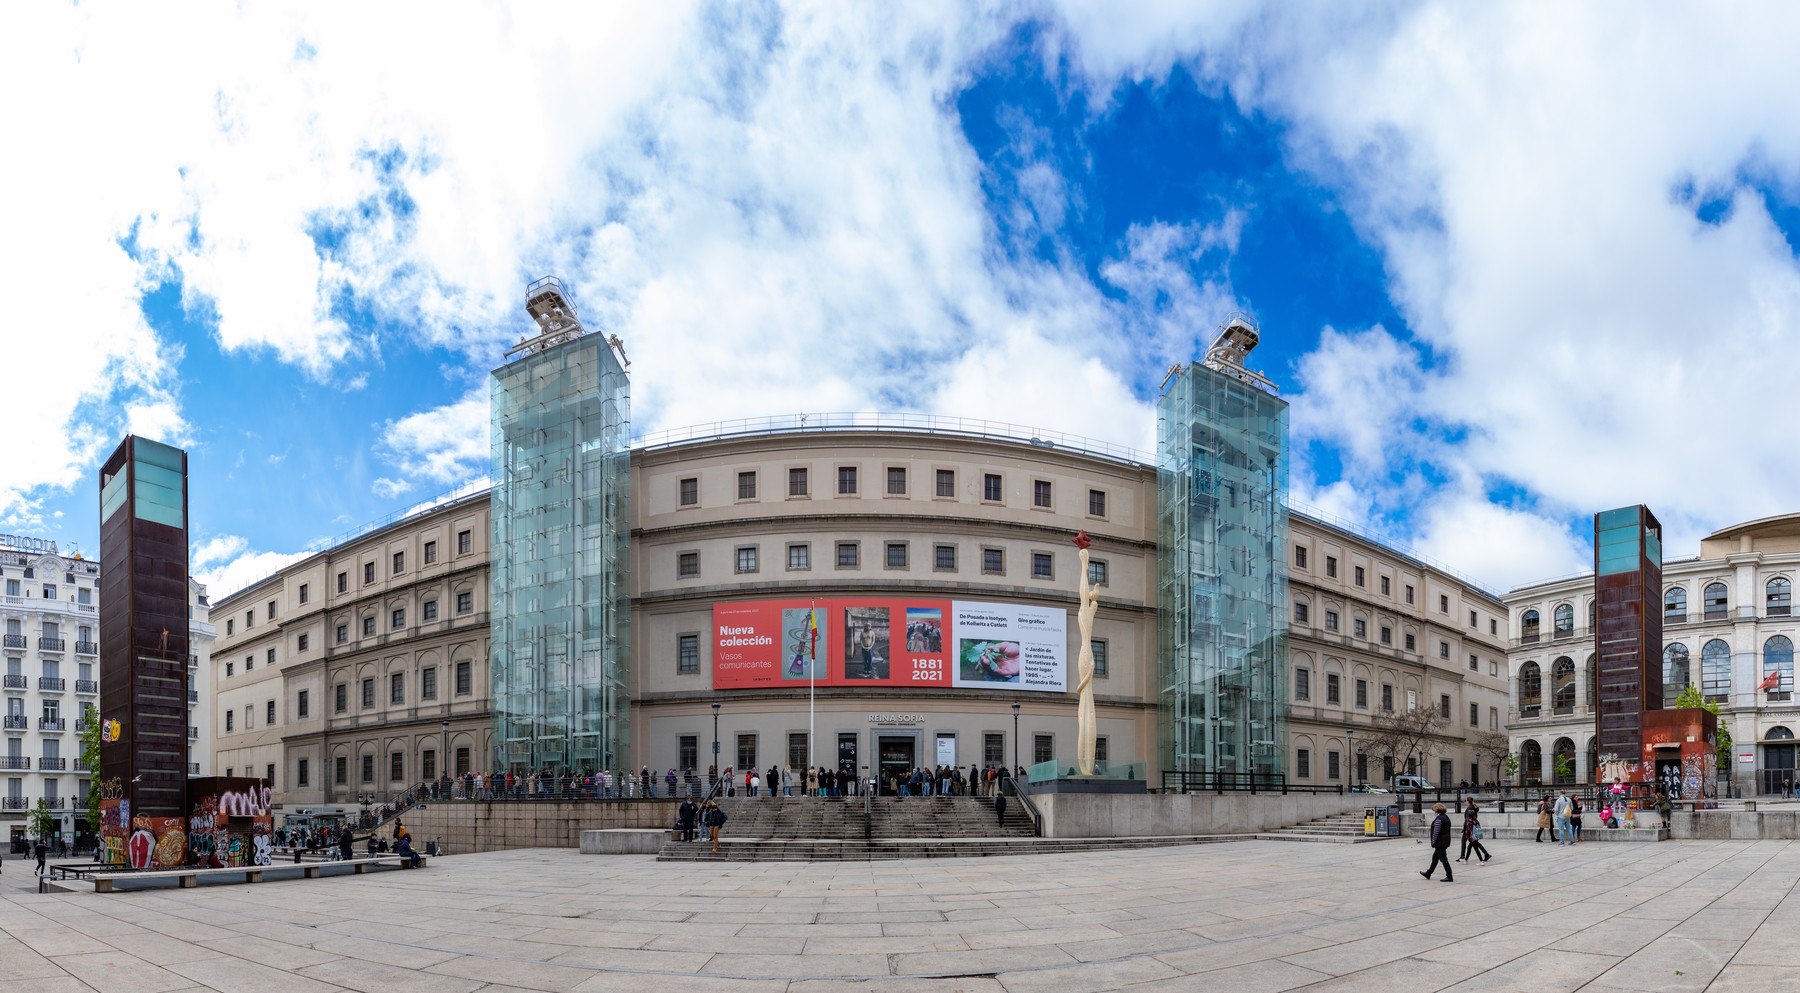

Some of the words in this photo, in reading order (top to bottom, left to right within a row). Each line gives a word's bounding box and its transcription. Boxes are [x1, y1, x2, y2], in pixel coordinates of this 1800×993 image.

[720, 625, 754, 636] Nueva
[720, 636, 772, 647] colección
[720, 652, 742, 660] Vasos
[720, 661, 772, 669] comunicantes
[912, 659, 943, 669] 1881
[912, 670, 943, 681] 2021
[868, 714, 896, 722] REINA
